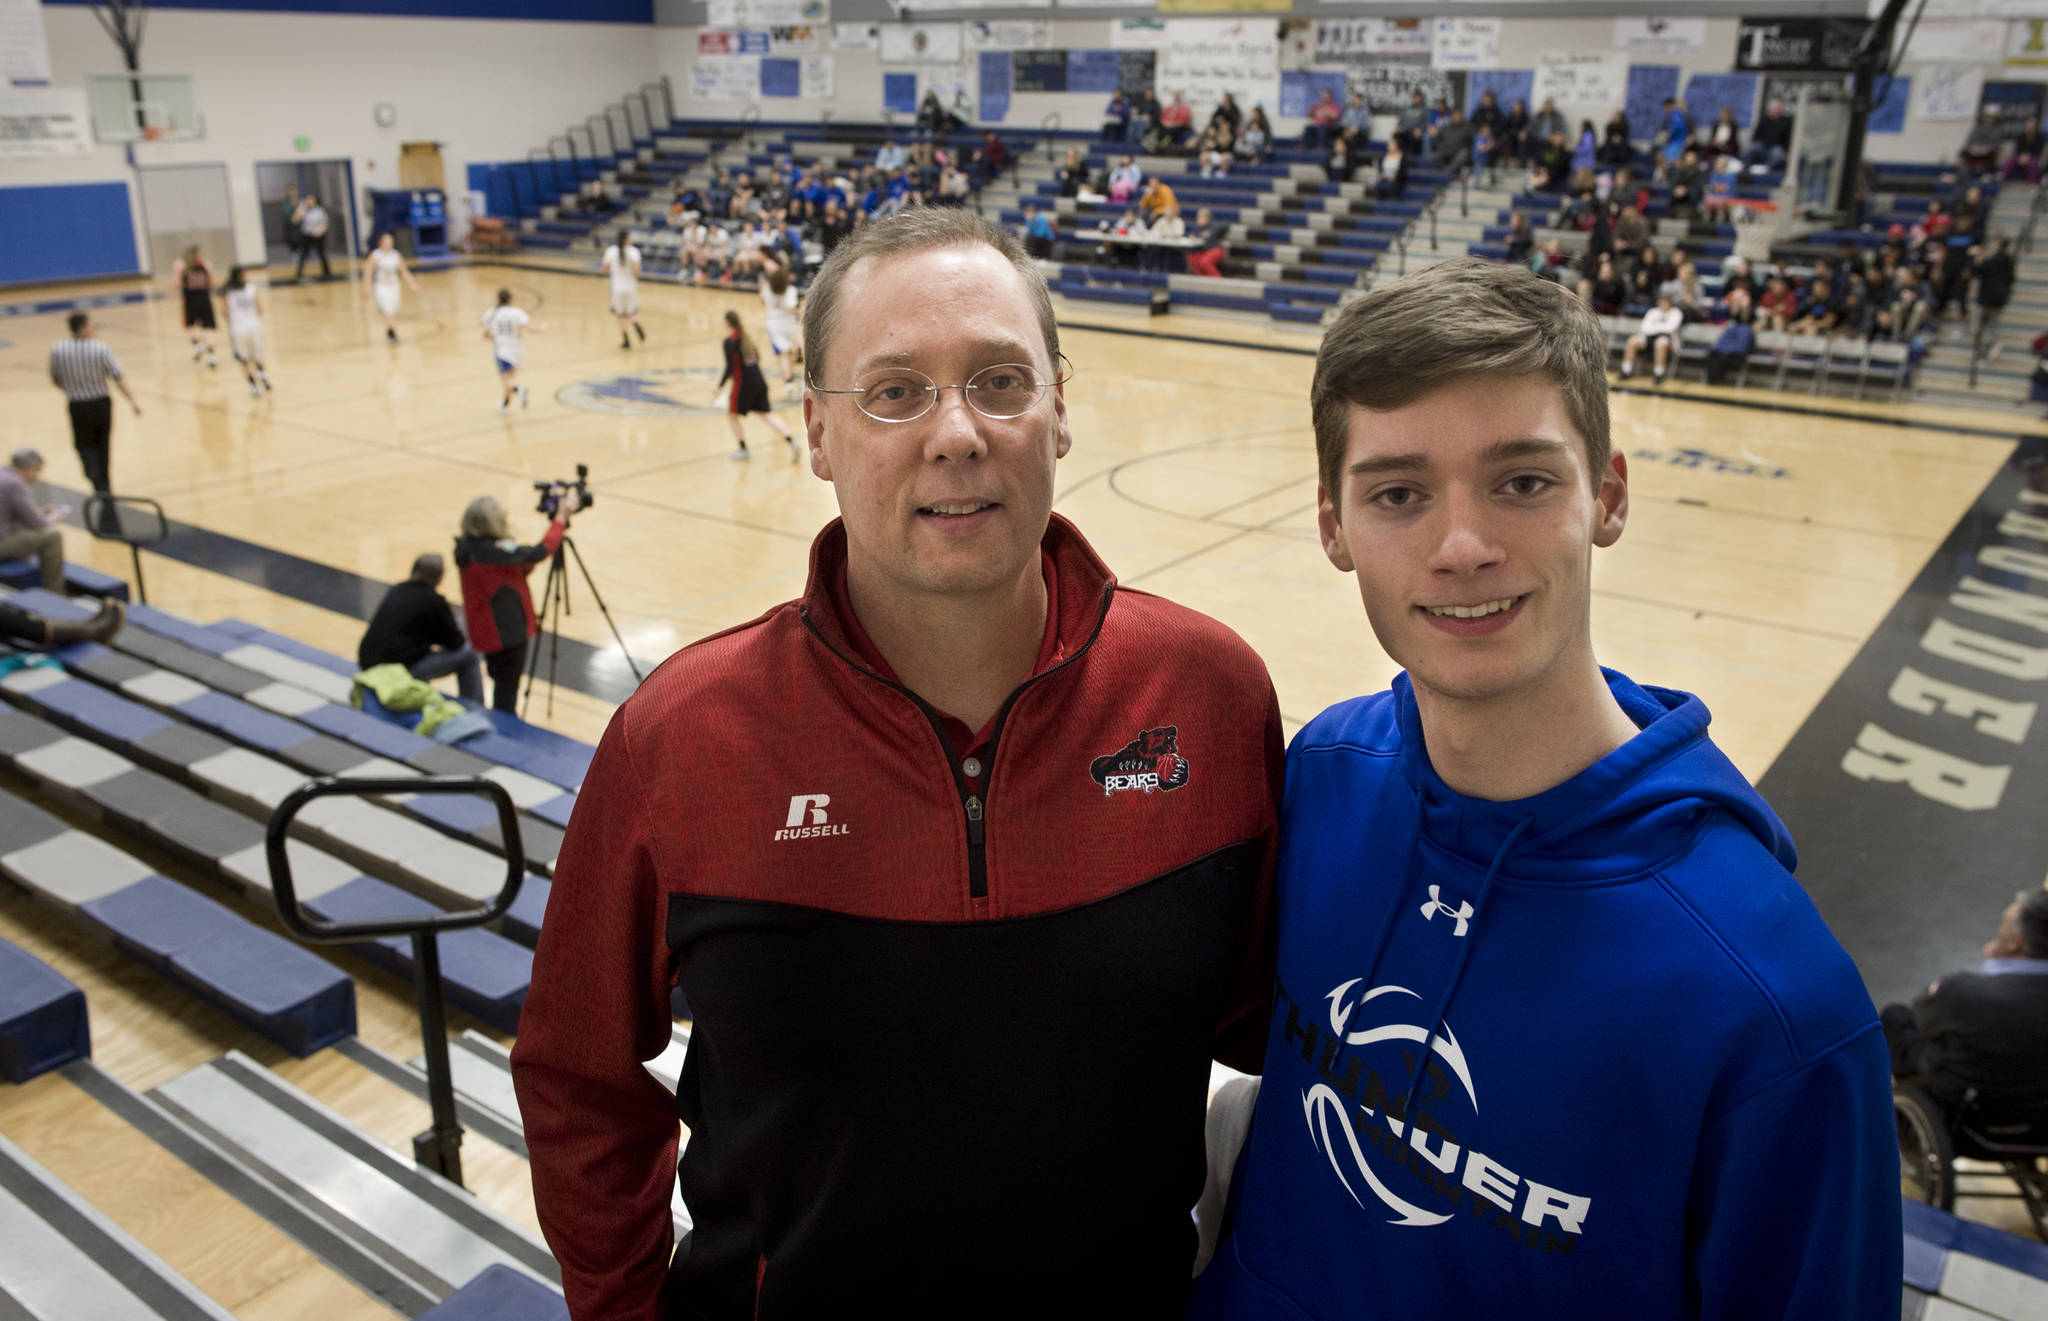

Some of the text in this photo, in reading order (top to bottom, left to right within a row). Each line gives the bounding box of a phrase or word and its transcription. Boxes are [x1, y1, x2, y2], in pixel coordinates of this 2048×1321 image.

[1841, 486, 2048, 811] UNDER
[1105, 772, 1159, 796] BEARS
[786, 793, 831, 827] R
[774, 823, 850, 841] RUSSELL
[1356, 1110, 1576, 1256] MOUNTAIN
